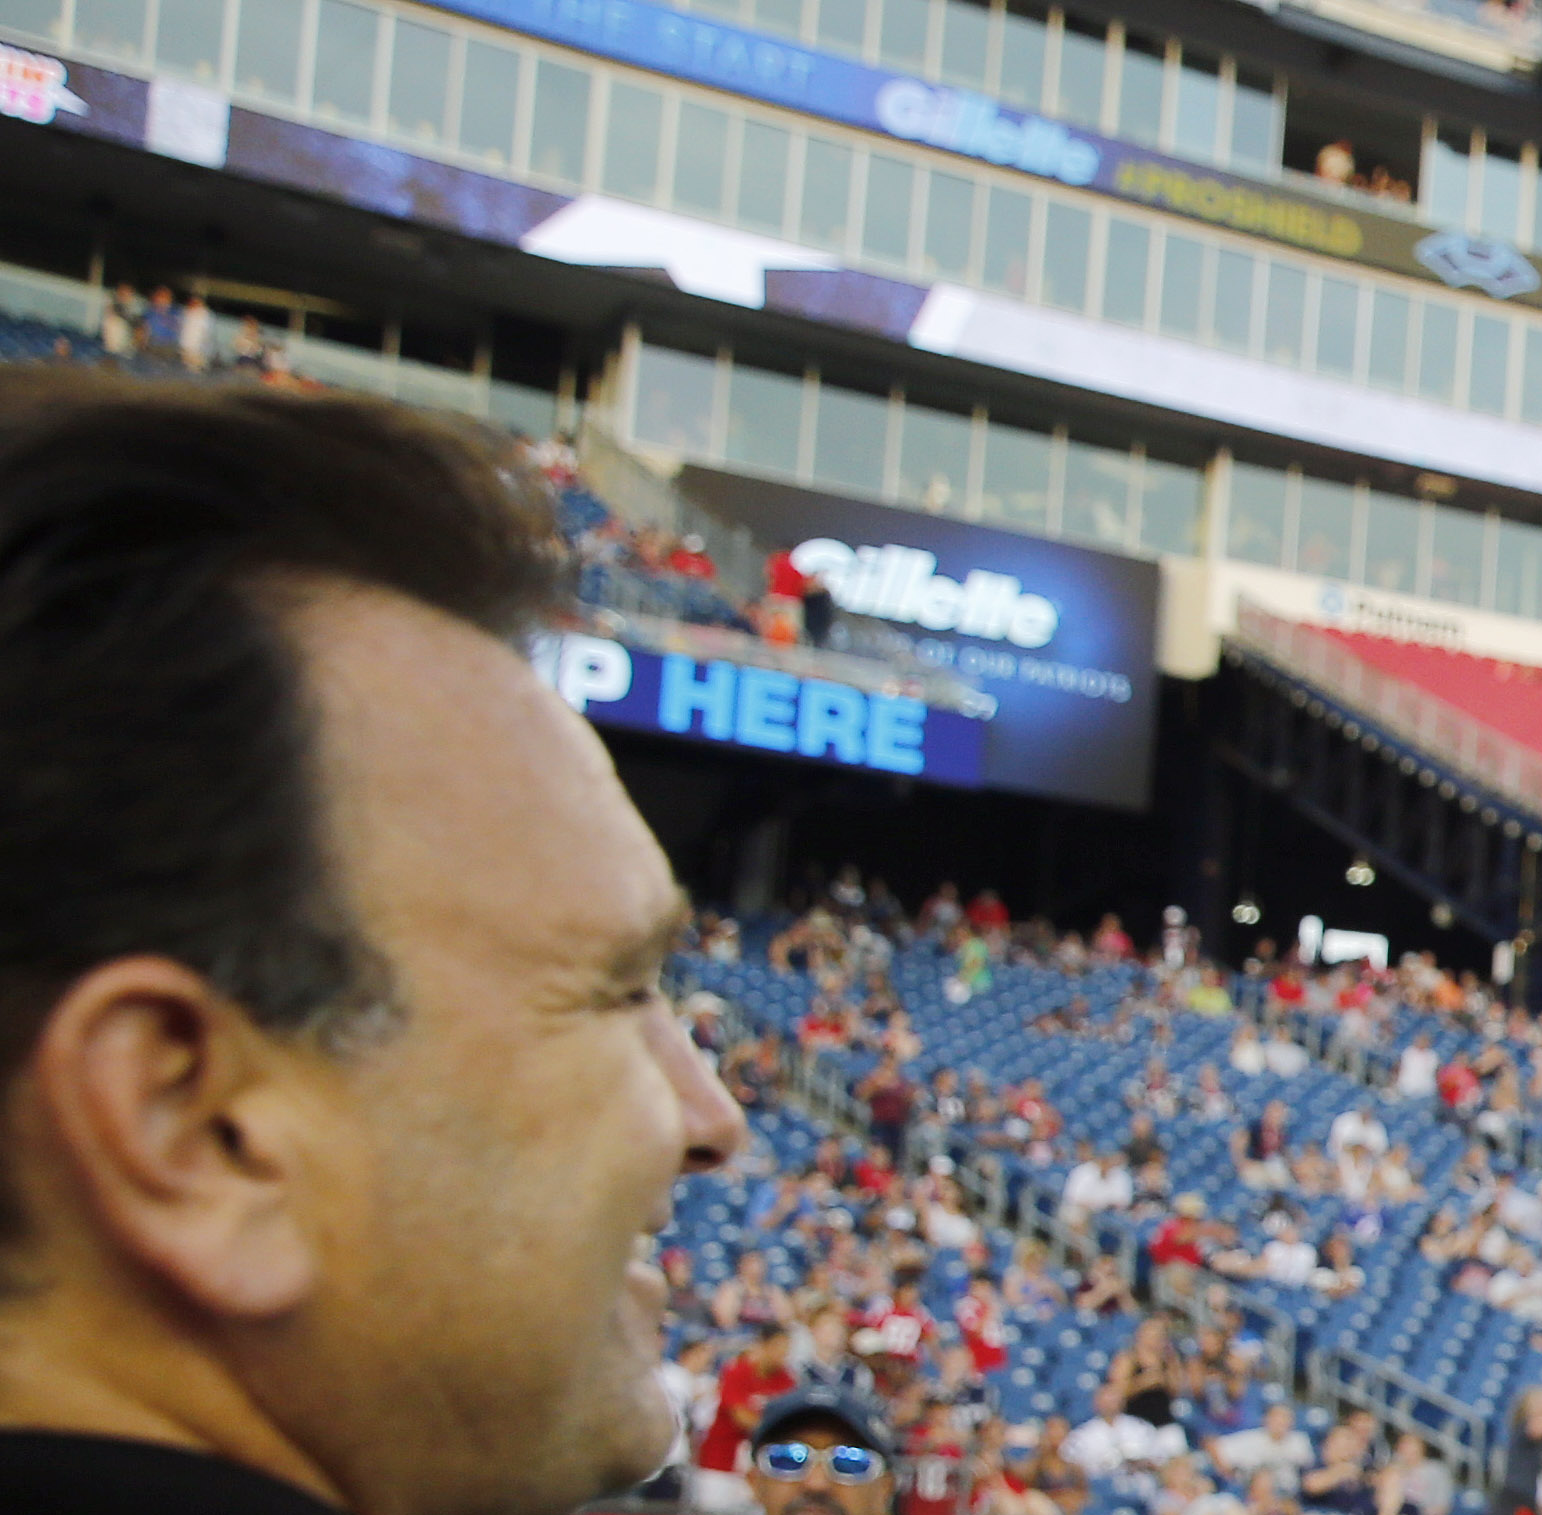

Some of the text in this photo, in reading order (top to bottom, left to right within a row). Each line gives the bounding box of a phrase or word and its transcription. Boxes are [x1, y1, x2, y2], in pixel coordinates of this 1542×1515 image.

[876, 77, 1099, 186] Gillette
[790, 538, 1059, 648] Gillette
[657, 651, 928, 775] HERE
